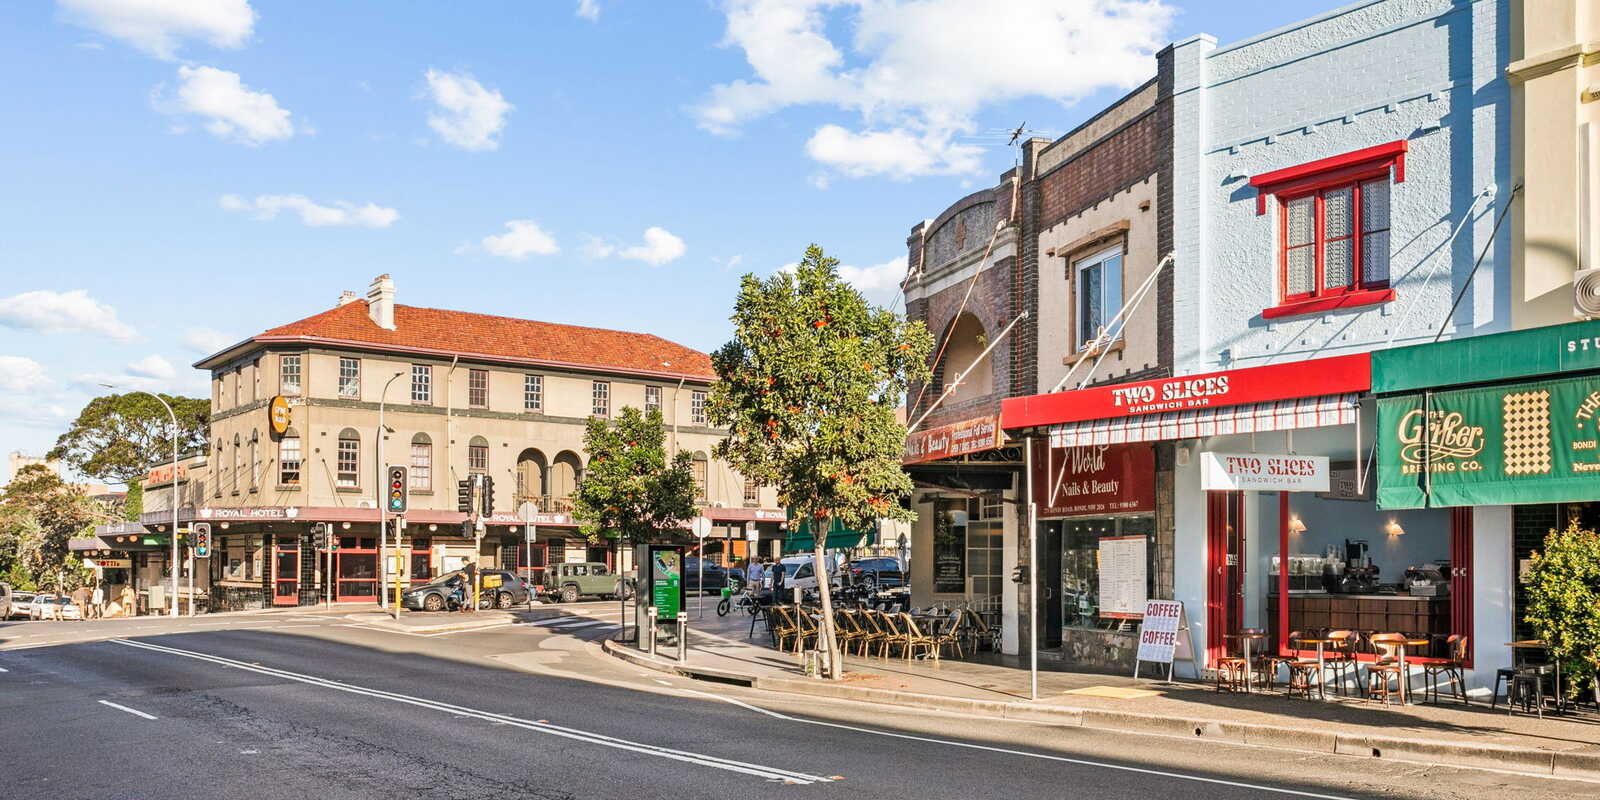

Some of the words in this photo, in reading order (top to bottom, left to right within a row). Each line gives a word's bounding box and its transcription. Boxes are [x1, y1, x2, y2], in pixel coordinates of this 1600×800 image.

[1112, 385, 1156, 407] TWO
[1162, 375, 1229, 401] SLICES
[1129, 401, 1183, 413] SANDWICH
[1187, 398, 1209, 407] BAR
[1572, 440, 1597, 450] BONDI
[1226, 456, 1262, 475] TWO
[1267, 457, 1318, 477] SLICES
[1460, 460, 1483, 471] CO.
[1061, 483, 1081, 497] Nails
[1082, 480, 1090, 495] &
[1091, 480, 1120, 496] Beauty
[1241, 477, 1283, 485] SANDWICH
[215, 509, 247, 518] ROYAL
[250, 509, 284, 518] HOTEL
[1146, 602, 1180, 618] COFFEE
[1142, 630, 1176, 646] COFFEE
